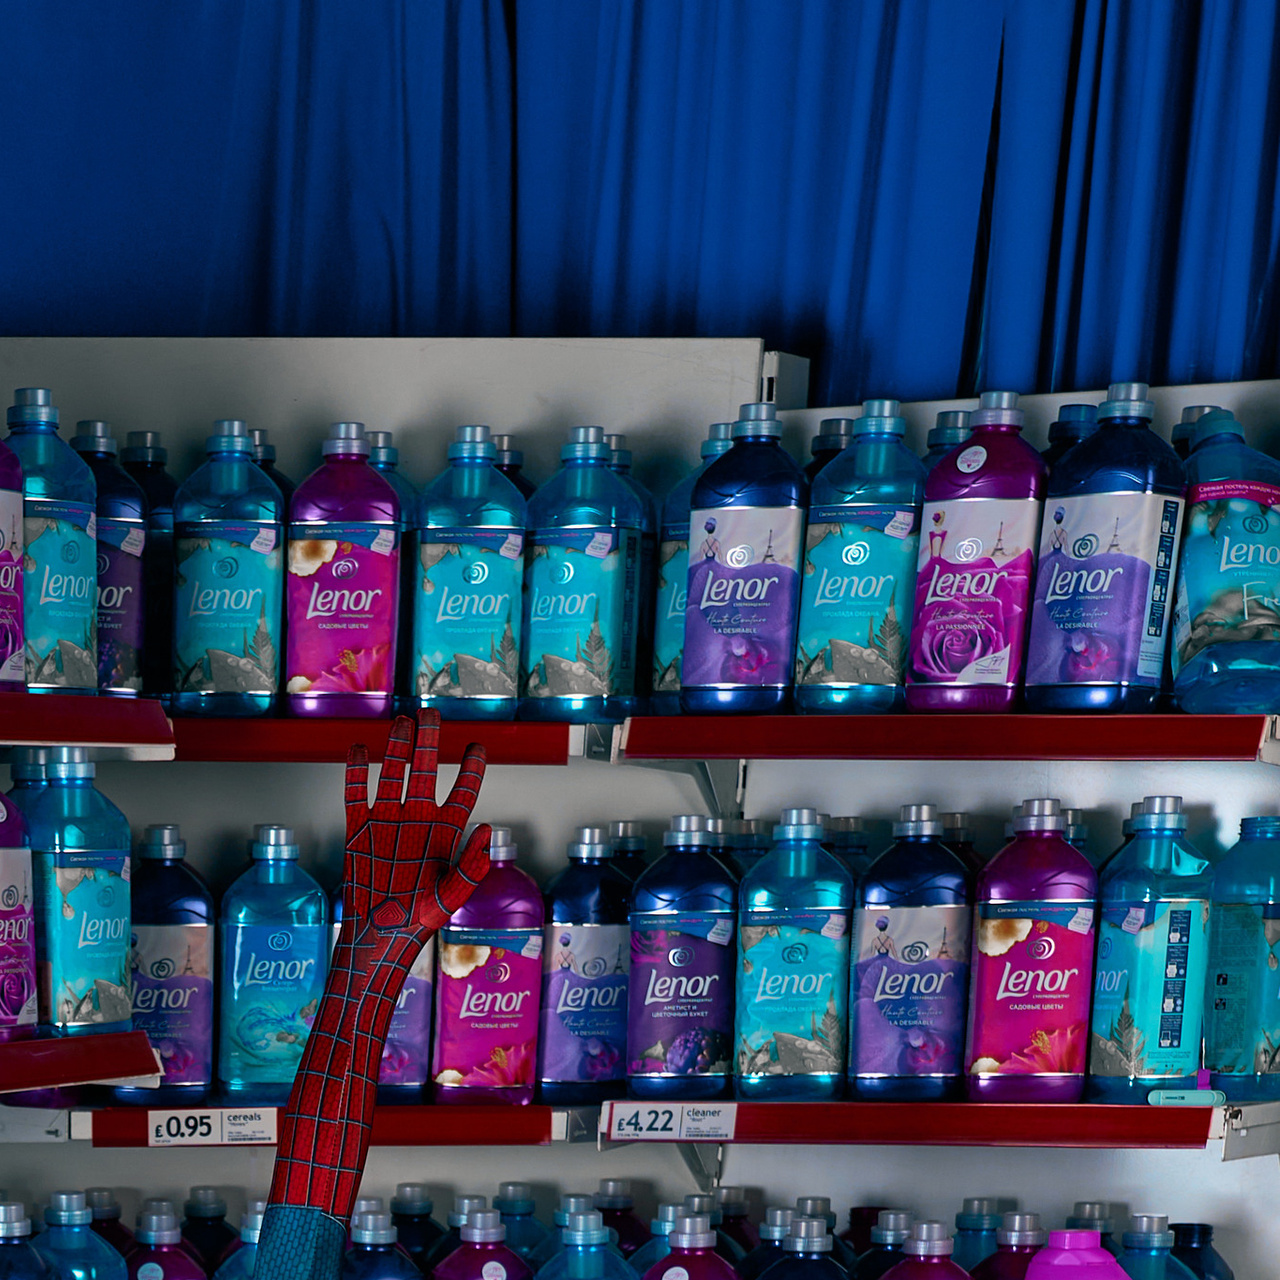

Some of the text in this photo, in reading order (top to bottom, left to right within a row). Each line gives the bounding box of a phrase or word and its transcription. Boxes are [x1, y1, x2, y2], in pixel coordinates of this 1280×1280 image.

[1220, 535, 1280, 573] Leno
[39, 564, 94, 605] Lenor
[189, 581, 262, 618] Lenor
[306, 581, 382, 620] Lenor
[700, 570, 779, 611] Lenor
[814, 567, 894, 608] Lenor
[925, 563, 1008, 605] Lenor
[1045, 563, 1124, 605] Lenor
[435, 586, 510, 623] Lenor
[531, 591, 597, 622] Lenor
[78, 910, 128, 949] Lenor
[244, 952, 315, 987] Lenor
[644, 968, 719, 1006] Lenor
[755, 967, 832, 1003] Lenor
[874, 966, 955, 1003] Lenor
[996, 961, 1079, 1001] Lenor
[459, 984, 531, 1020] Lenor
[556, 979, 627, 1015] Lenor
[227, 1112, 262, 1122] cereals
[686, 1108, 722, 1117] cleaner
